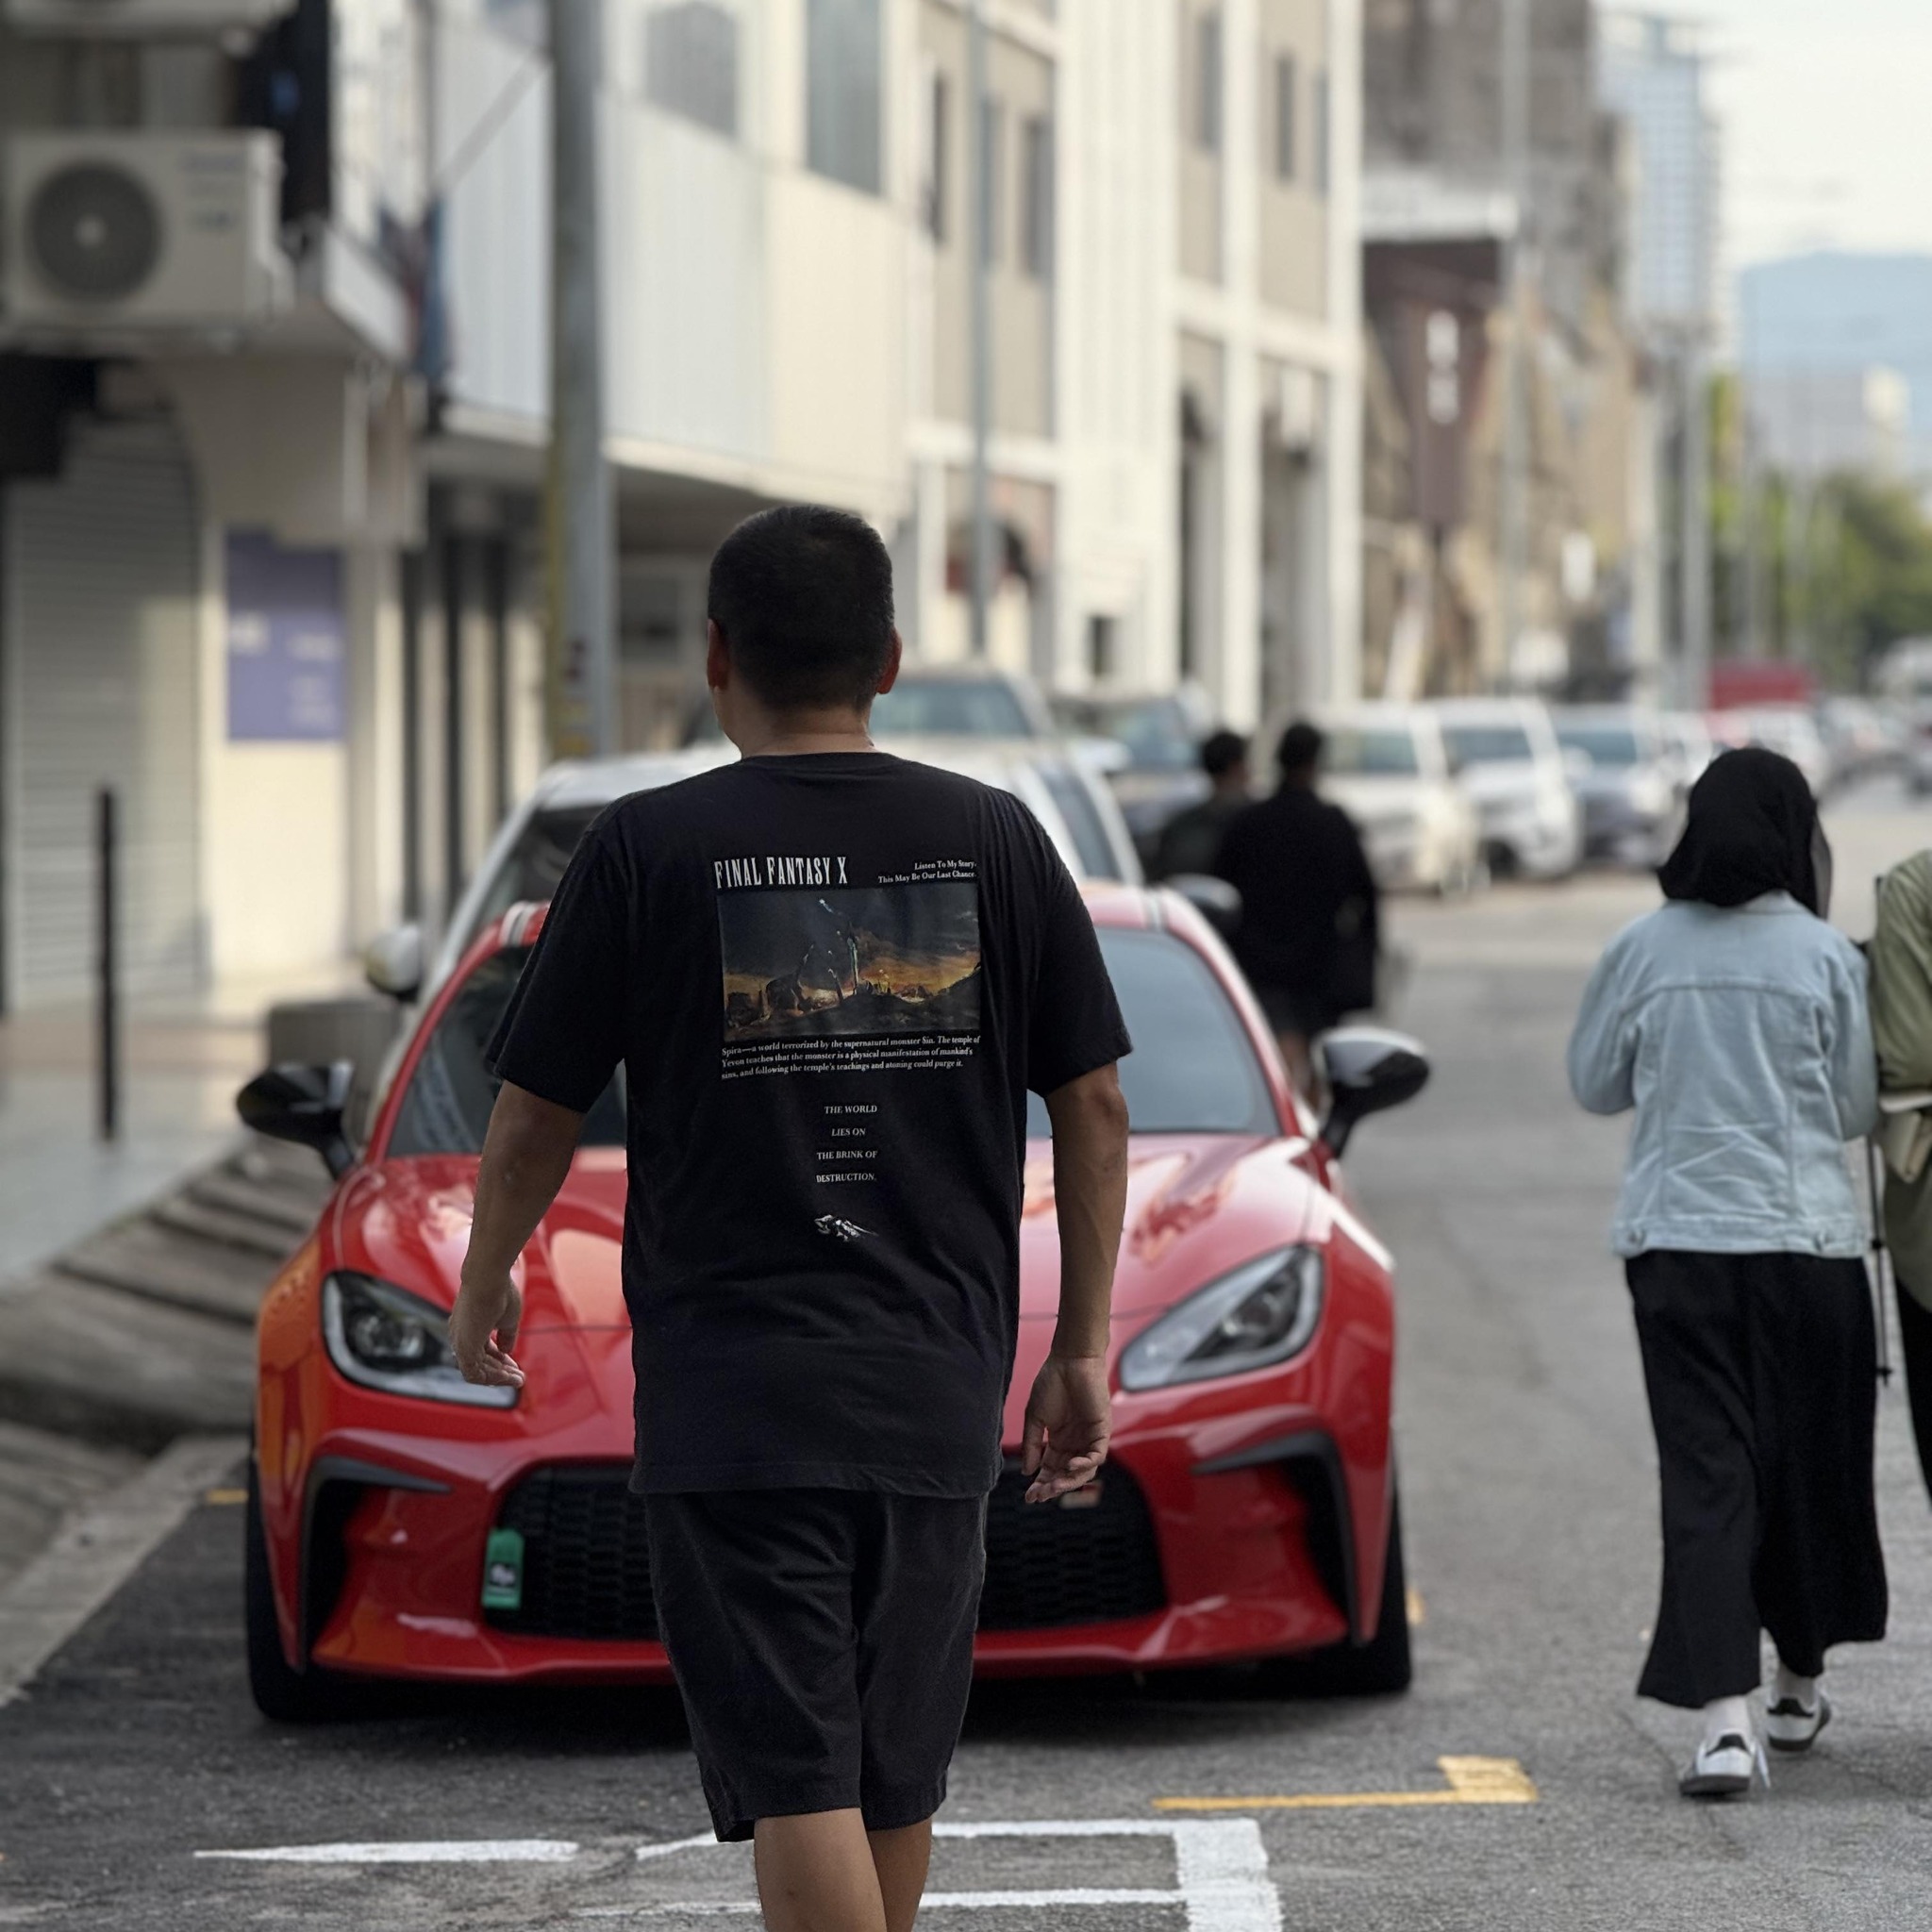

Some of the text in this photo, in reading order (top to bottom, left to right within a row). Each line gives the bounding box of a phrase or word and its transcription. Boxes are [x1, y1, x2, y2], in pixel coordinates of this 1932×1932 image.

[914, 861, 936, 870] Listen
[947, 859, 958, 869] My
[714, 857, 848, 889] FINAL FANTASY X
[758, 1041, 780, 1052] world
[781, 1040, 819, 1049] terrorized
[820, 1040, 829, 1049] by
[831, 1040, 842, 1048] the
[843, 1038, 890, 1049] supernatural
[891, 1038, 921, 1046] monster
[922, 1036, 935, 1044] Sin.
[952, 1036, 973, 1045] temple
[722, 1058, 745, 1068] Yevon
[746, 1055, 774, 1064] teaches
[774, 1053, 790, 1061] that
[837, 1050, 844, 1059] is
[850, 1049, 879, 1060] physical
[880, 1047, 930, 1057] manifestation
[931, 1047, 941, 1056] of
[721, 1072, 739, 1080] sins,
[740, 1067, 754, 1076] and
[755, 1065, 789, 1075] following
[790, 1063, 803, 1072] the
[837, 1061, 869, 1072] teachings
[871, 1060, 884, 1069] and
[885, 1060, 912, 1070] atoning
[913, 1059, 933, 1068] could
[934, 1060, 955, 1070] purge
[824, 1105, 877, 1114] THE WORLD
[831, 1127, 866, 1137] LIES ON
[816, 1150, 878, 1160] THE BRINK OF
